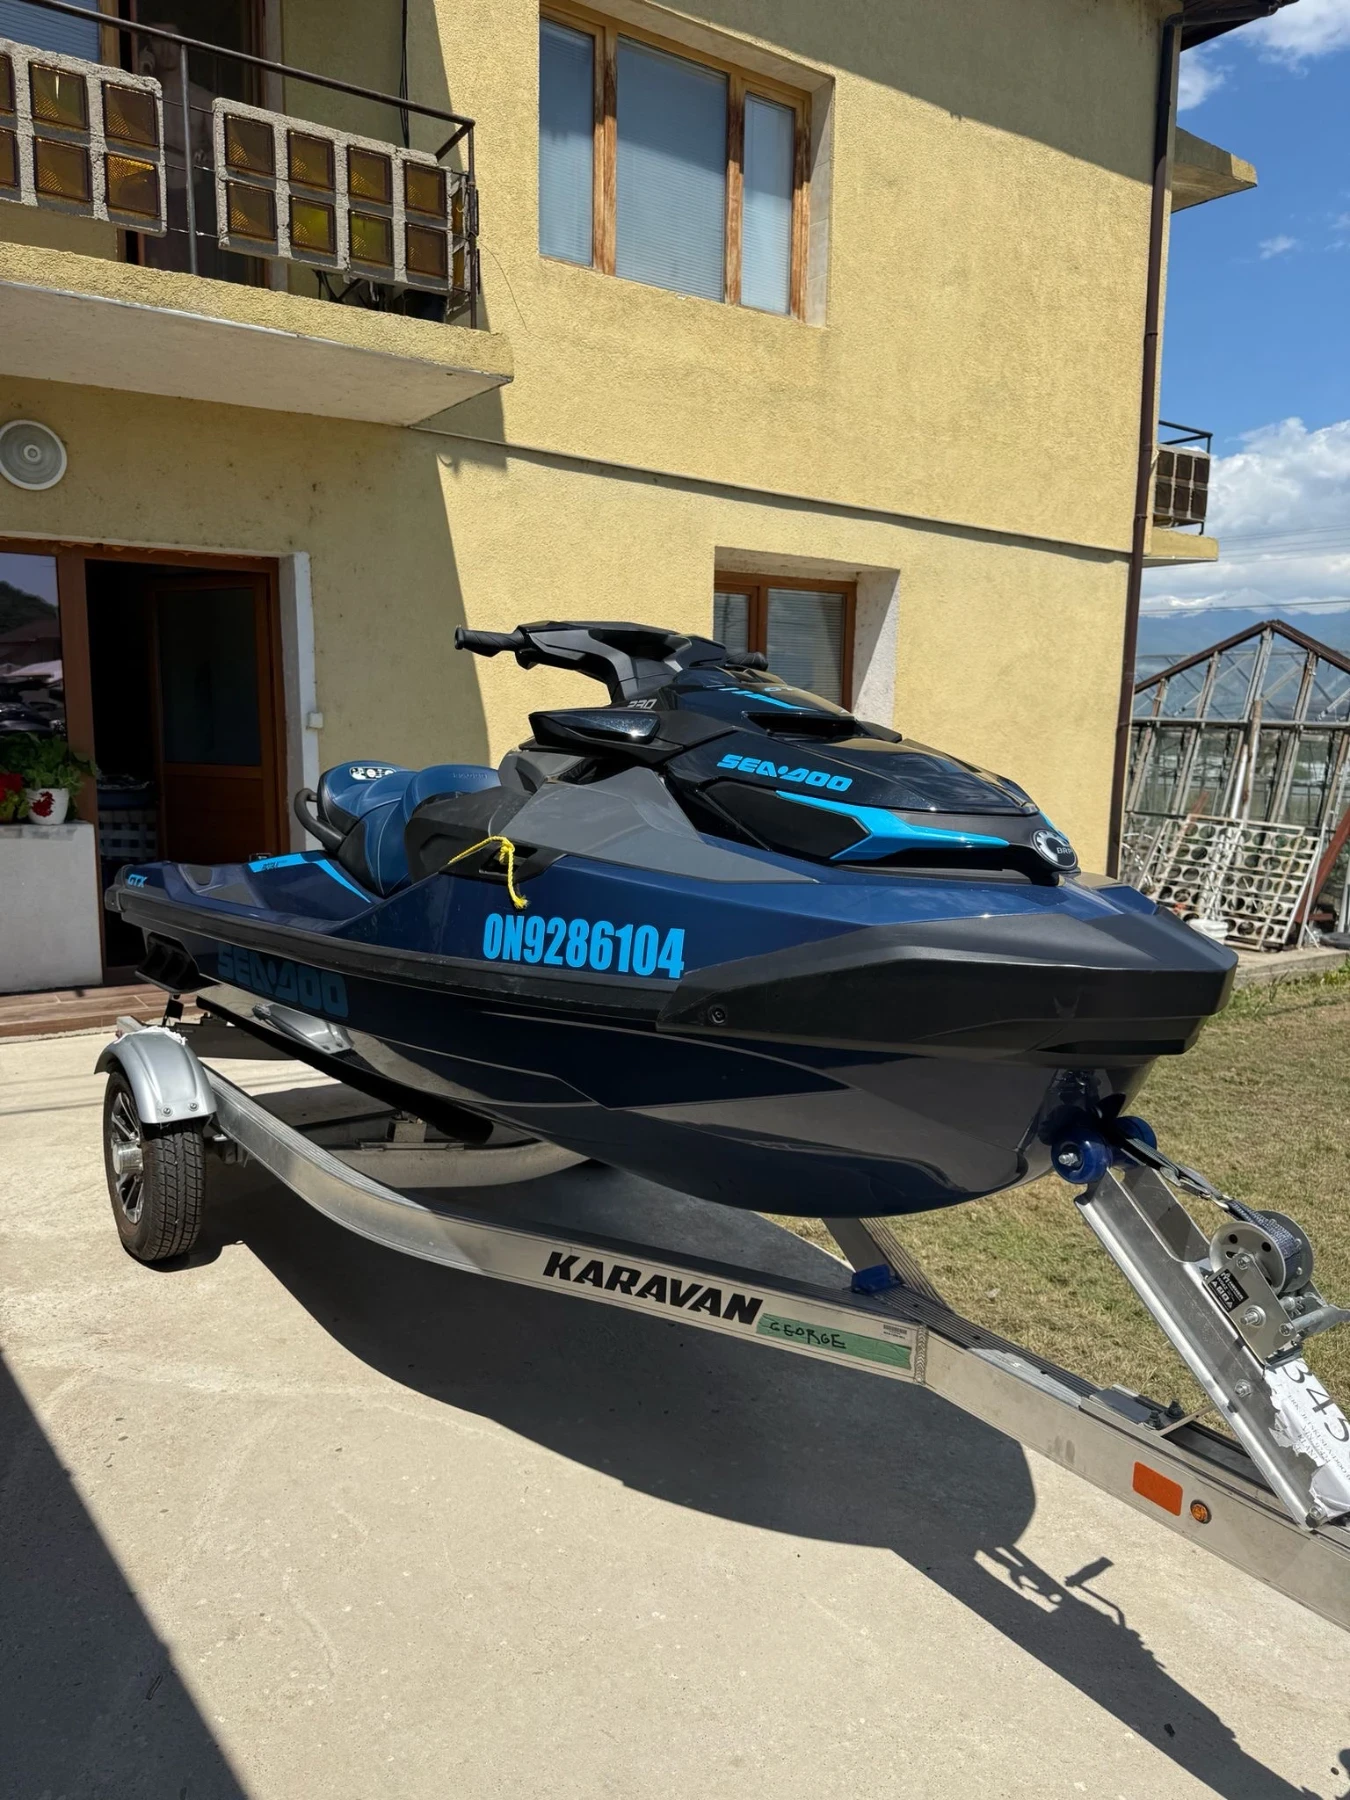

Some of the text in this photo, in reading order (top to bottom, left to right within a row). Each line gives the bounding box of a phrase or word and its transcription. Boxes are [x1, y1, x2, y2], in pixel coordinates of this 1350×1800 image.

[127, 873, 148, 888] GTX
[543, 1251, 764, 1326] KARAVAN
[769, 1322, 847, 1349] GEORGE
